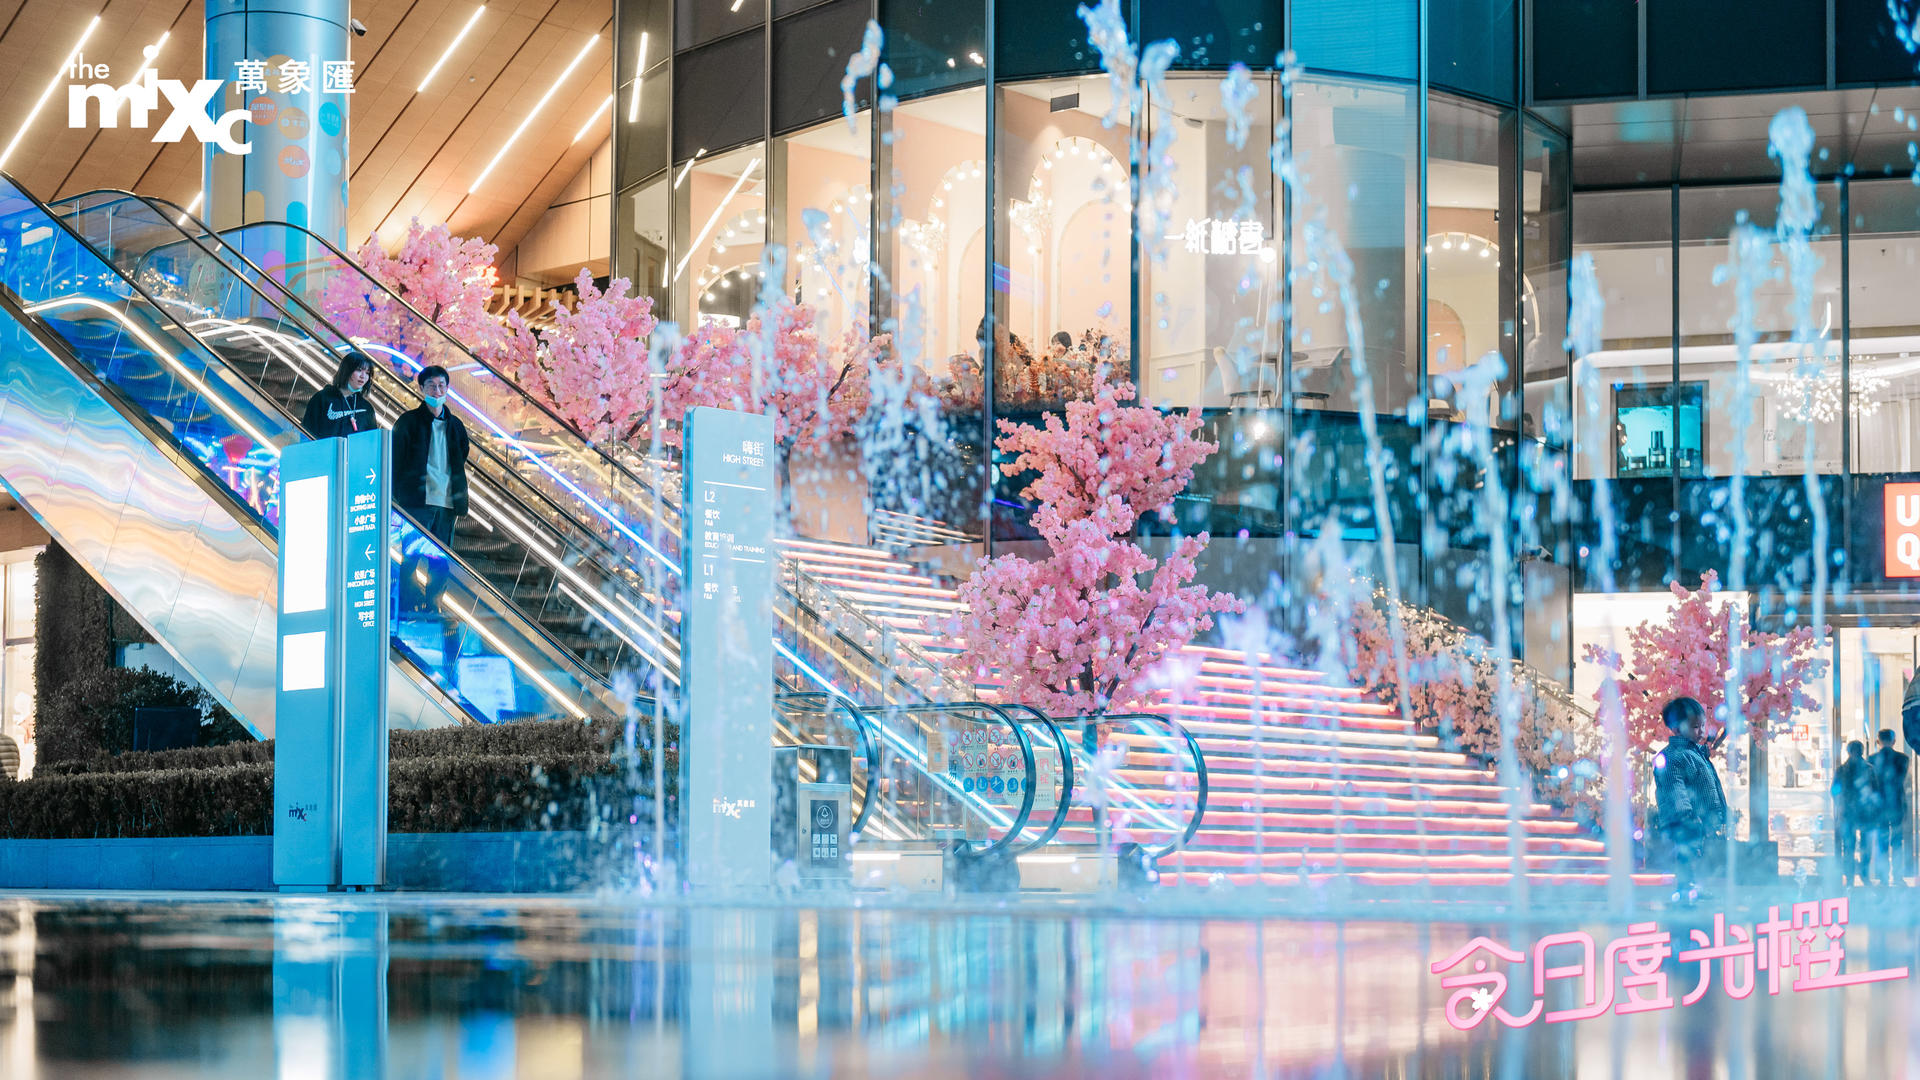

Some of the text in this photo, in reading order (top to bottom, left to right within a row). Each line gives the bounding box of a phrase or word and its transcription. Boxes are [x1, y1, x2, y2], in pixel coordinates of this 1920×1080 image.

[722, 454, 765, 467] HIGH STREET
[704, 490, 716, 503] L2
[703, 563, 714, 576] L1
